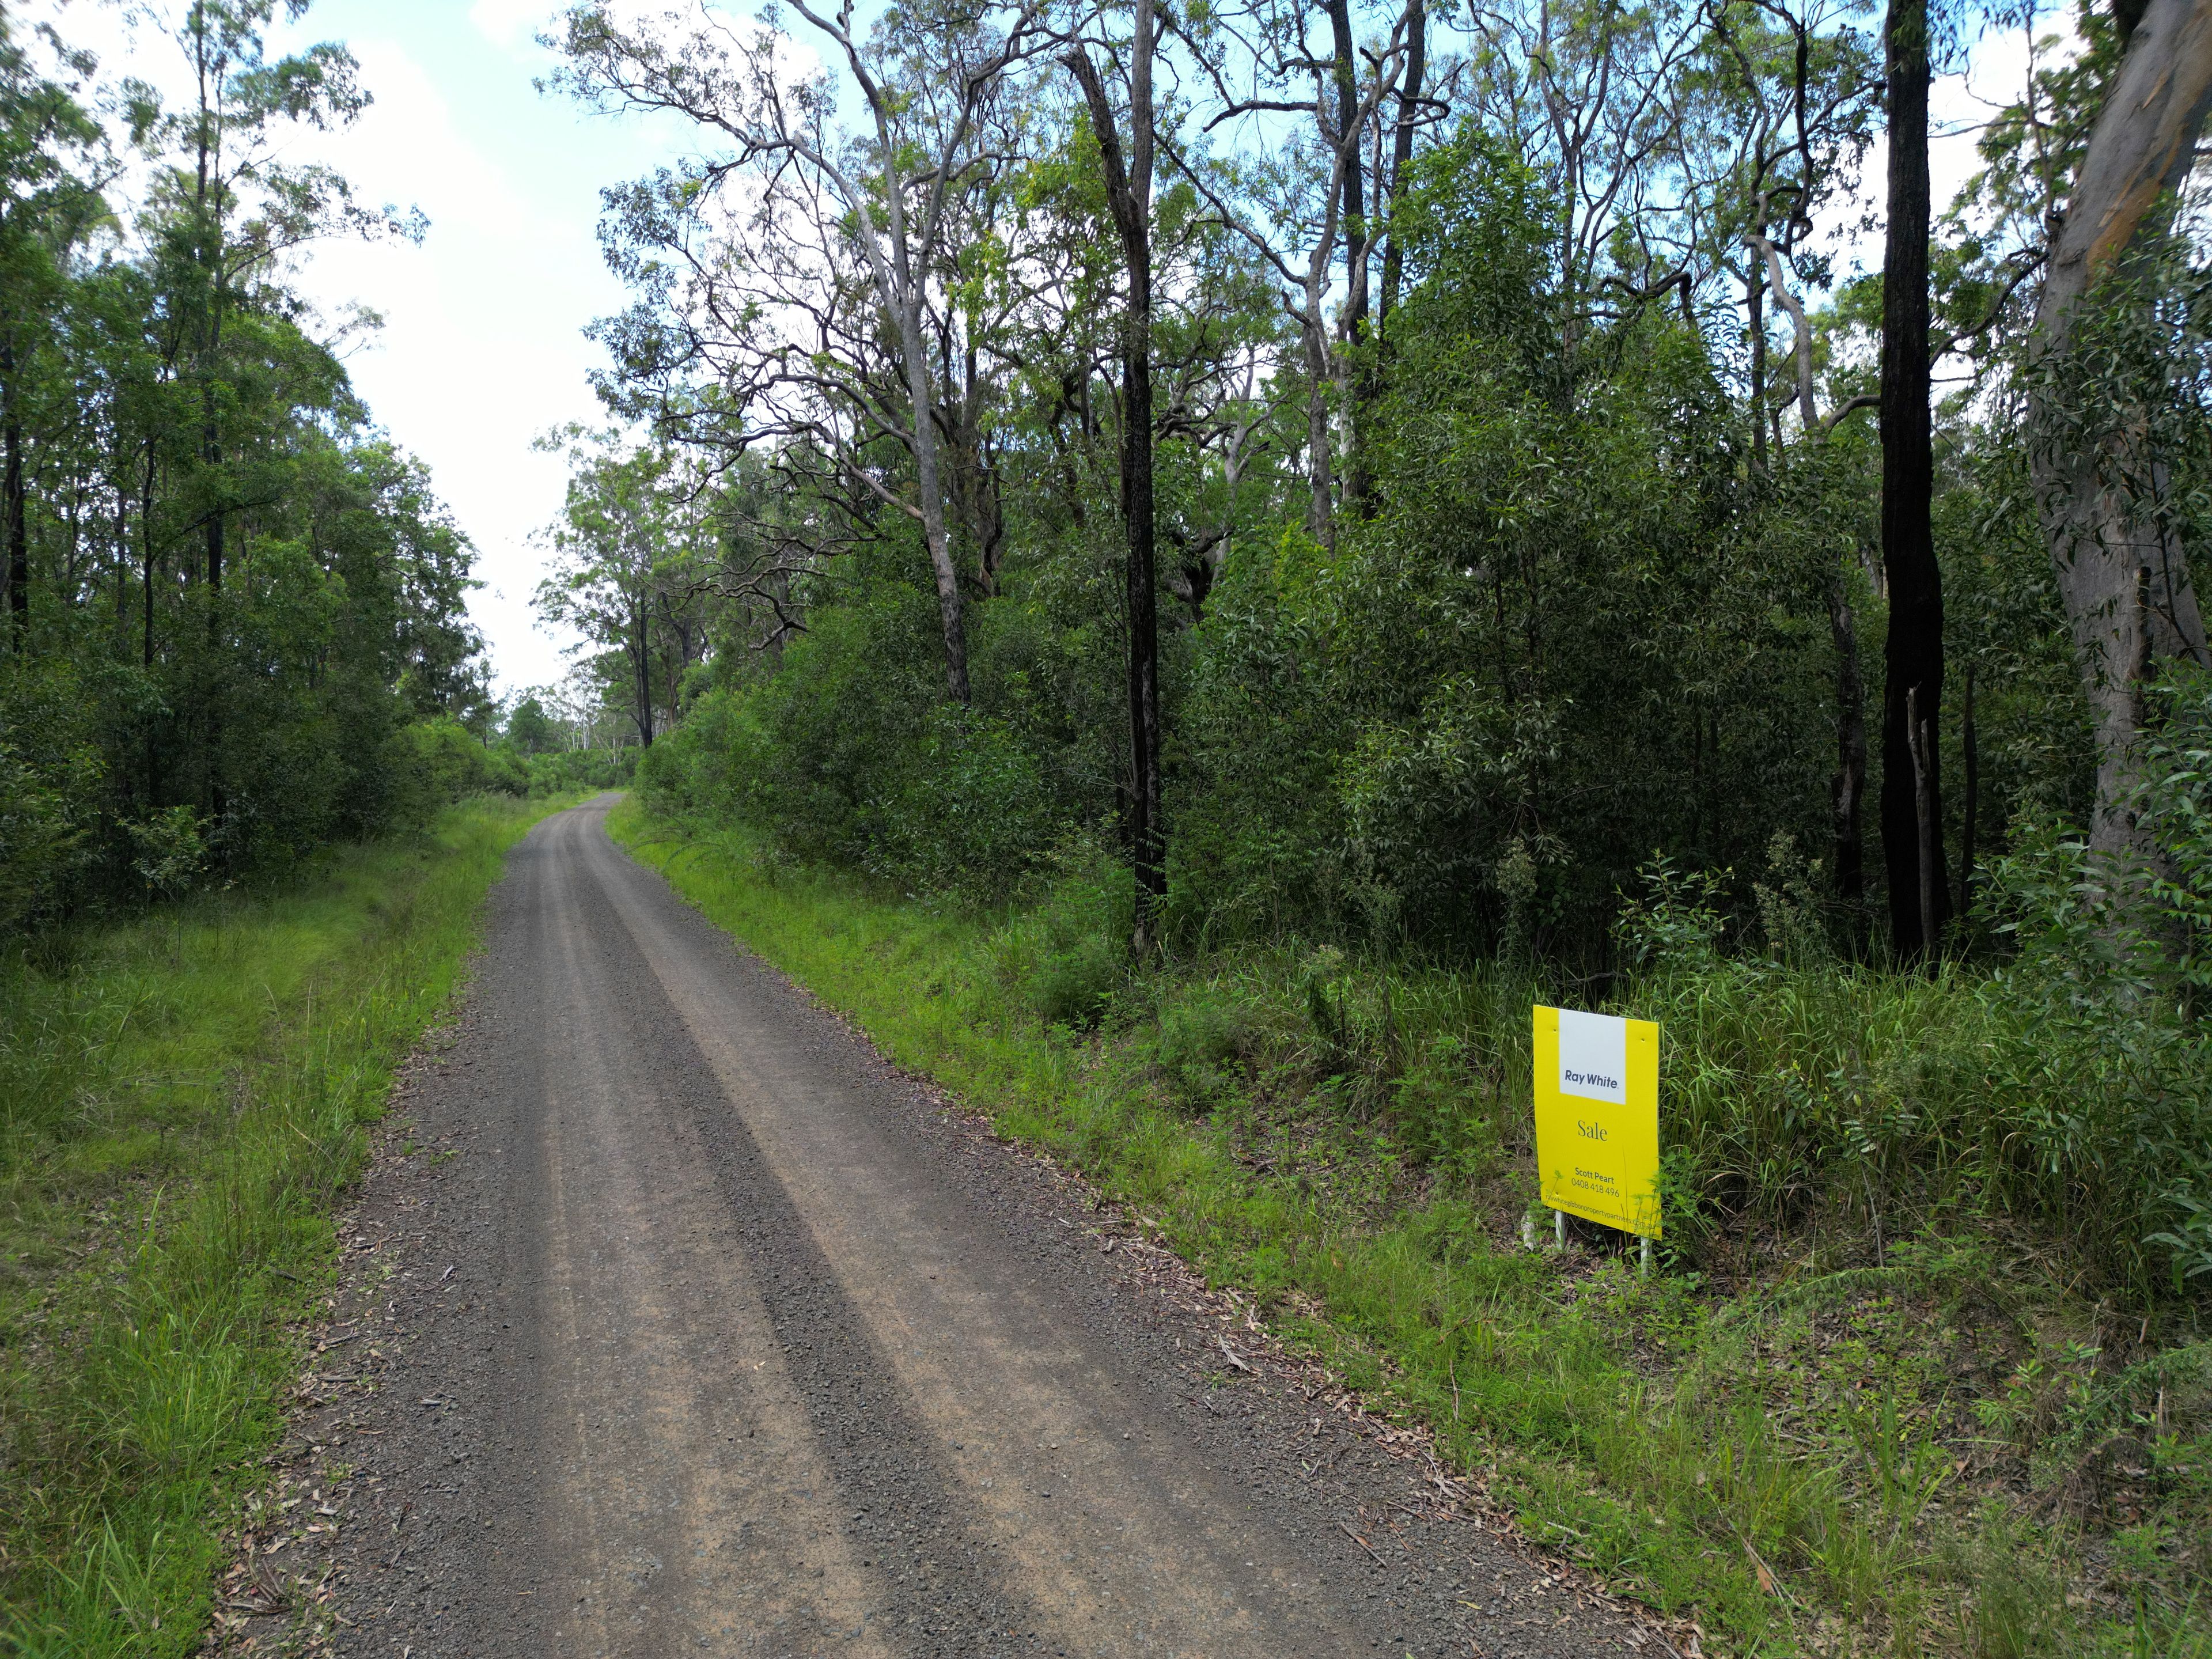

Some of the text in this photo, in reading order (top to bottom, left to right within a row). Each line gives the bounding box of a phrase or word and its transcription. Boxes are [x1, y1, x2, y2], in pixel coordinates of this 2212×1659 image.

[1565, 1070, 1618, 1089] Ray White
[1578, 1120, 1608, 1142] Sale
[1575, 1167, 1614, 1184] Scott Peart
[1571, 1178, 1619, 1197] 0408 418 496
